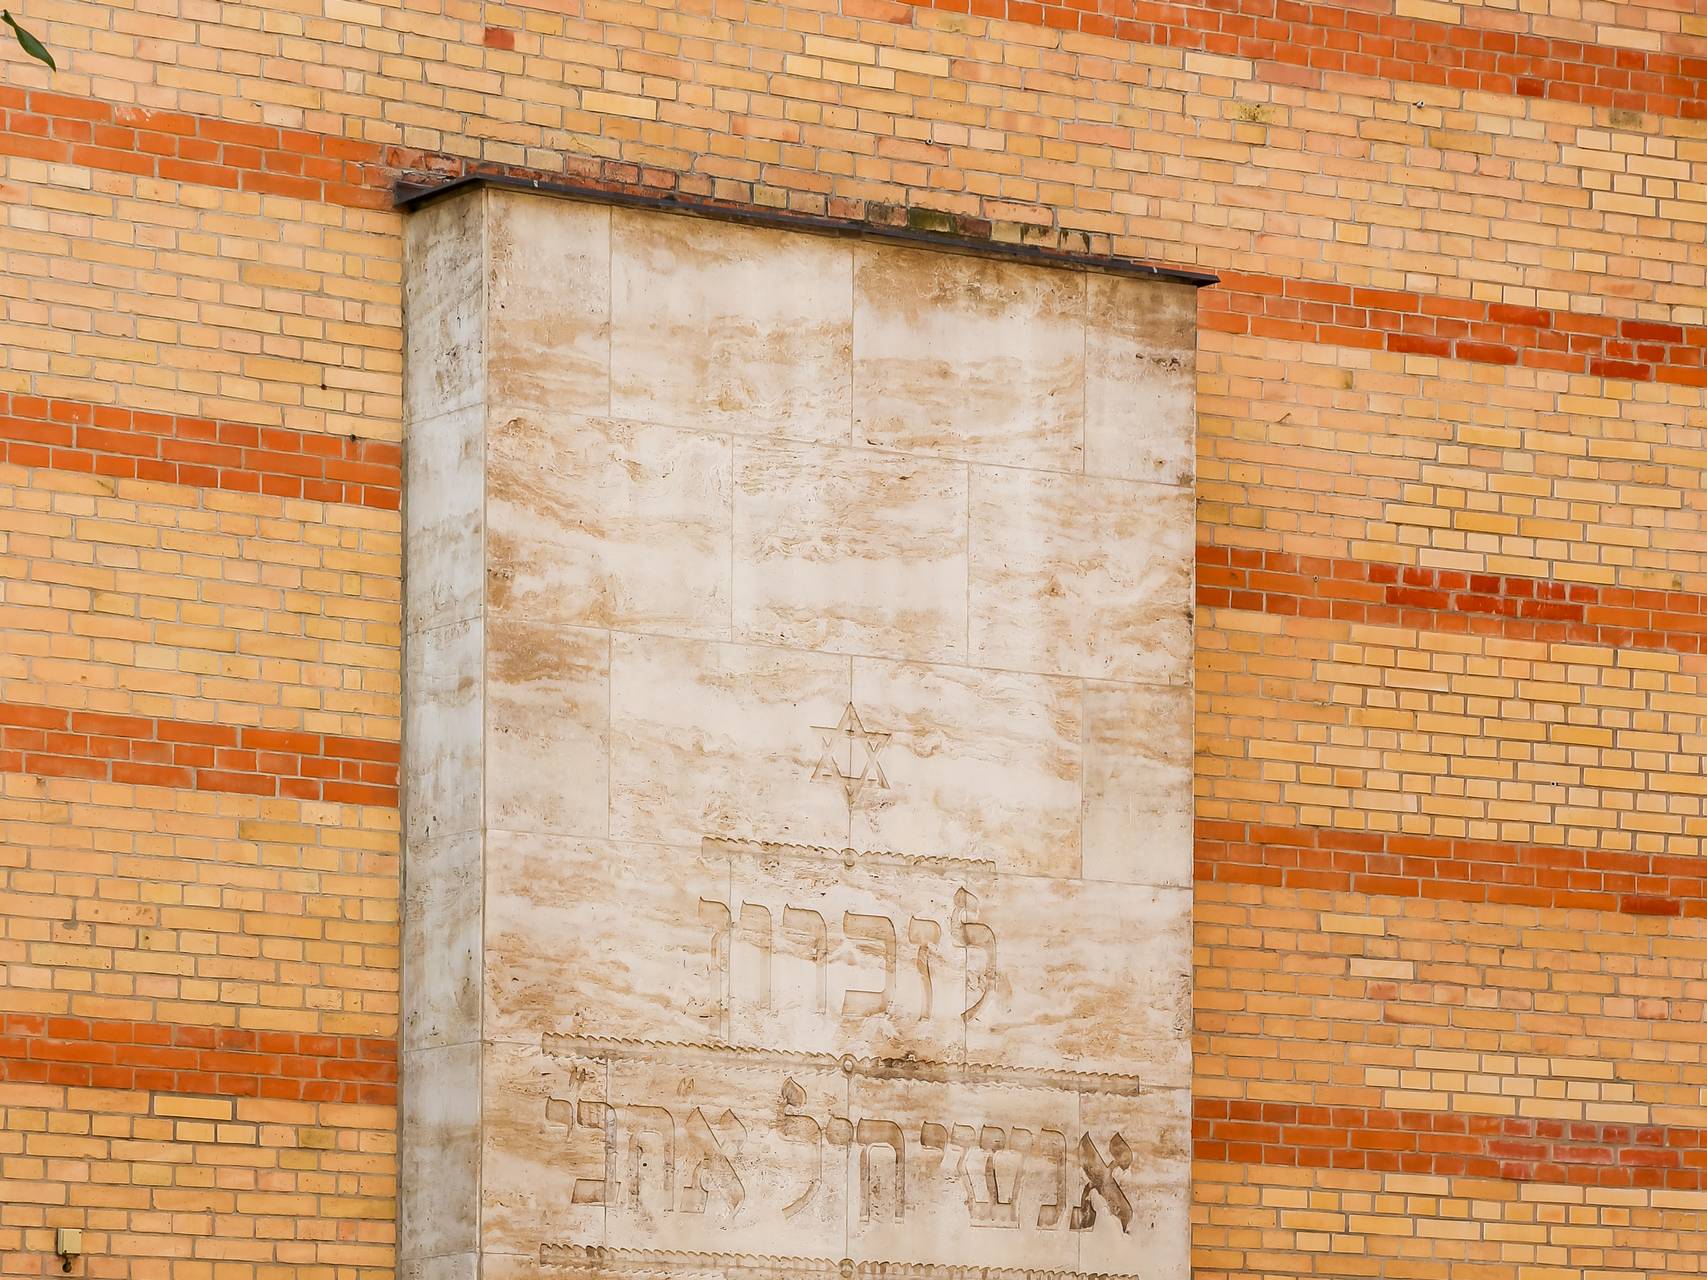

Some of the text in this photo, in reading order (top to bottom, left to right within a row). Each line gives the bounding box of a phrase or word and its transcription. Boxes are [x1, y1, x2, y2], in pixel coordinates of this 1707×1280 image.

[698, 886, 997, 1039] לזכרון
[777, 1076, 906, 1224] חיל
[920, 1120, 1133, 1235] אנשי
